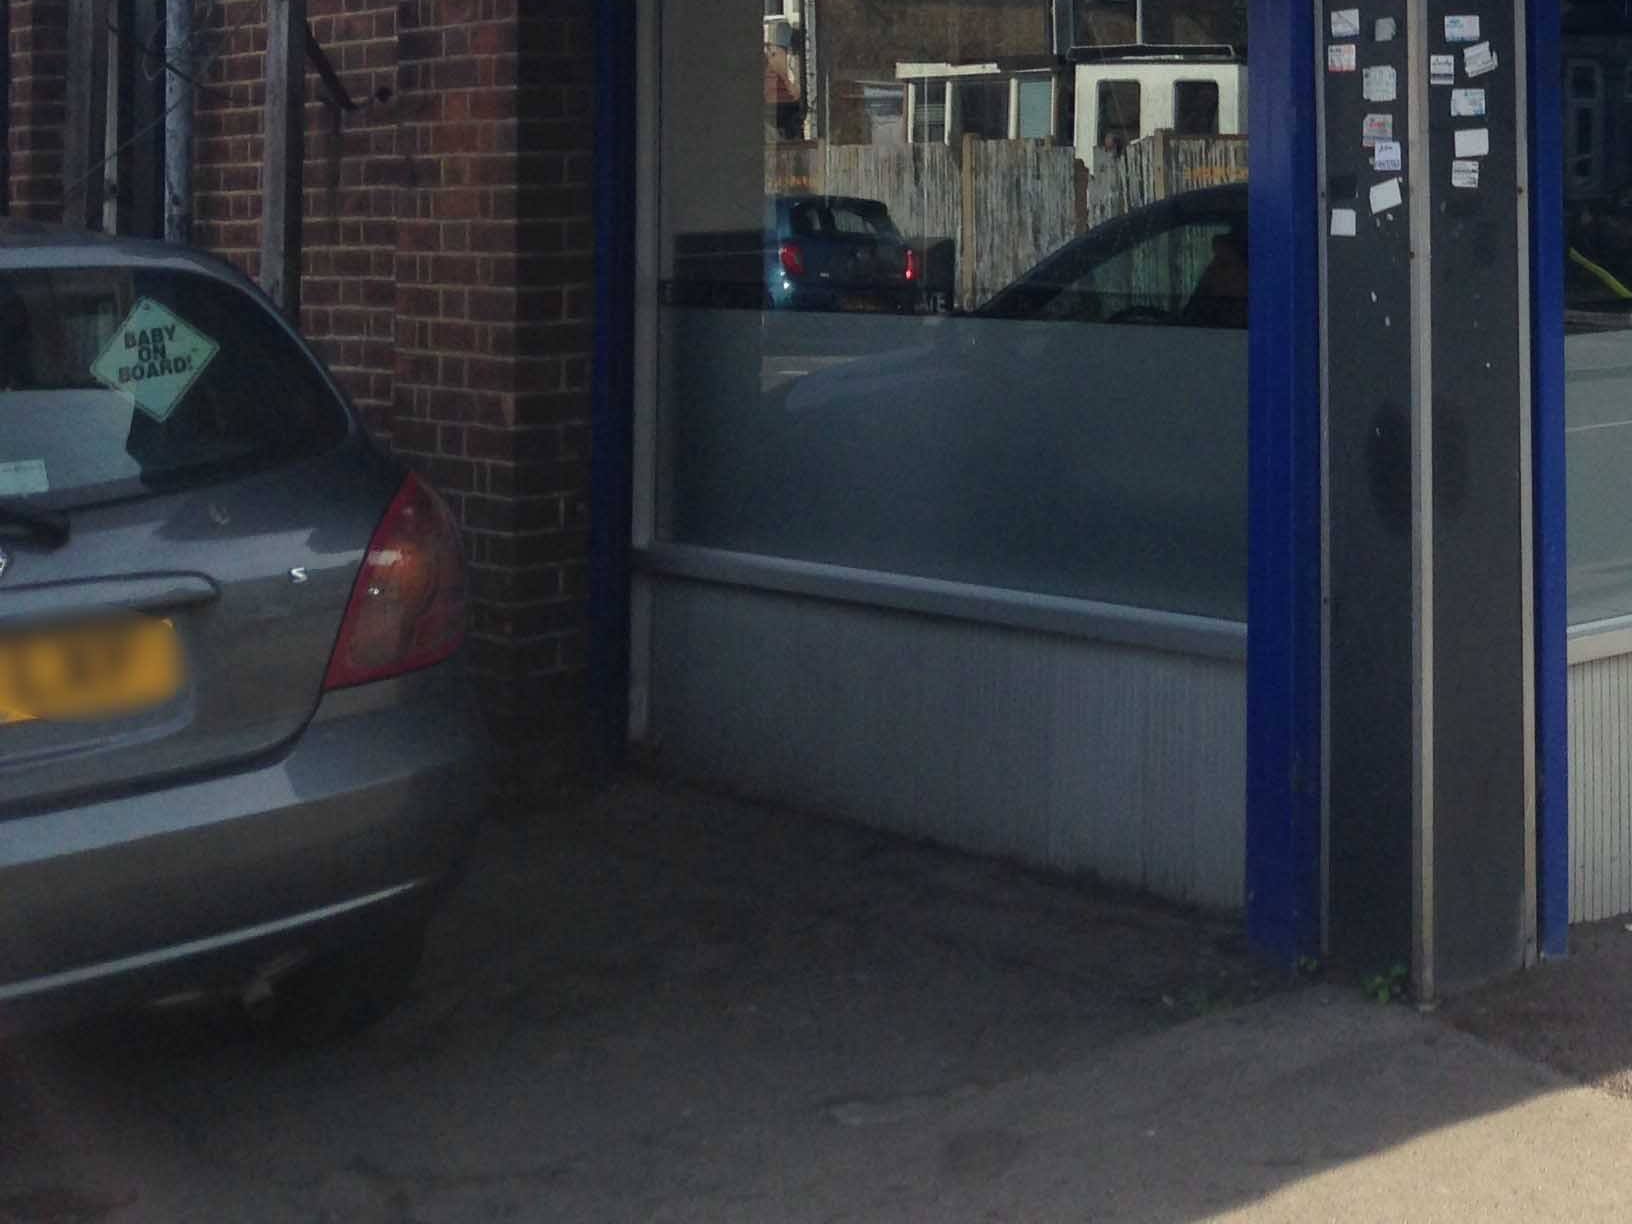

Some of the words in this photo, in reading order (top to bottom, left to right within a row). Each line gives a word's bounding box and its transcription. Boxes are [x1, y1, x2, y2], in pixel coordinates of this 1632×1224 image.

[125, 326, 177, 349] BABY
[138, 346, 167, 362] ON
[118, 356, 193, 384] BOARD!
